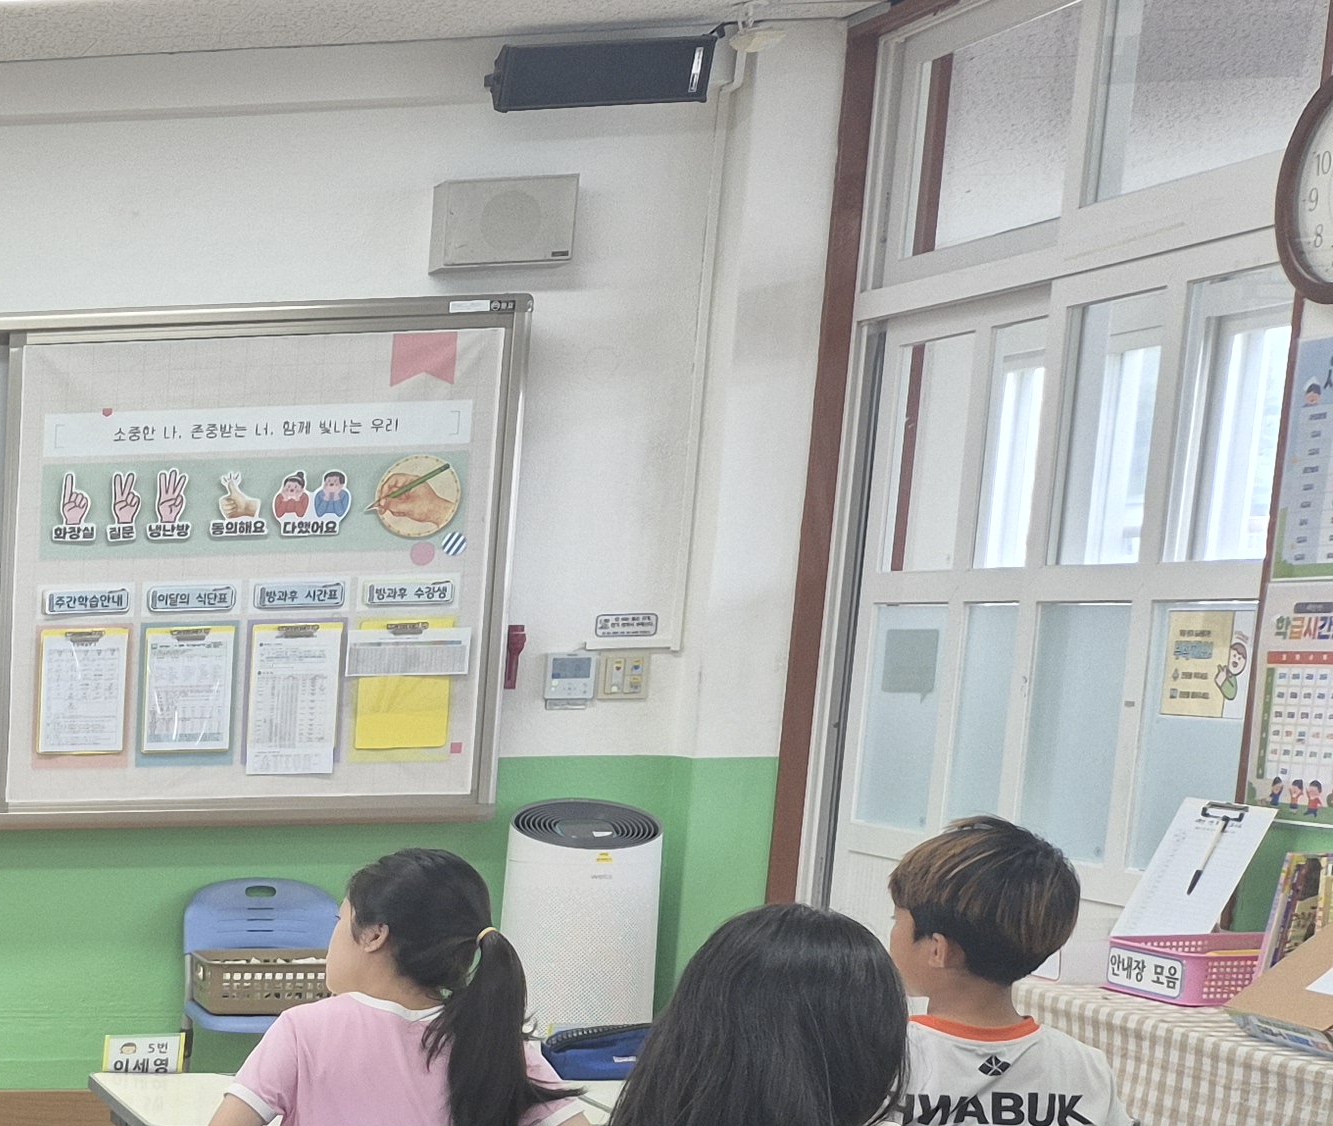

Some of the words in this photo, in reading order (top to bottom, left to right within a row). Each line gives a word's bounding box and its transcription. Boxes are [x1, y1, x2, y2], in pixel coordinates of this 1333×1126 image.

[1316, 151, 1331, 176] 10
[1308, 188, 1319, 211] 9
[1314, 224, 1324, 248] 8
[113, 427, 157, 442] 소중한
[191, 423, 247, 440] 존중받는
[283, 420, 311, 437] 함께
[319, 419, 363, 436] 빛나는
[371, 417, 399, 433] 우리
[52, 526, 95, 541] 화장실
[108, 526, 135, 540] 질문
[147, 523, 191, 540] 냉난방
[210, 520, 267, 536] 동의해요
[282, 519, 338, 535] 다했어요
[156, 591, 191, 606] 이달의
[195, 590, 228, 606] 식단표
[265, 589, 299, 604] 방과후
[304, 588, 339, 603] 시간표
[374, 586, 408, 601] 방과후
[413, 585, 448, 600] 수강생
[54, 594, 124, 609] 주간학습안내
[1109, 954, 1146, 985] 안내장
[1150, 963, 1180, 992] 모음
[148, 1042, 169, 1054] 5번
[113, 1056, 170, 1074] 이세영
